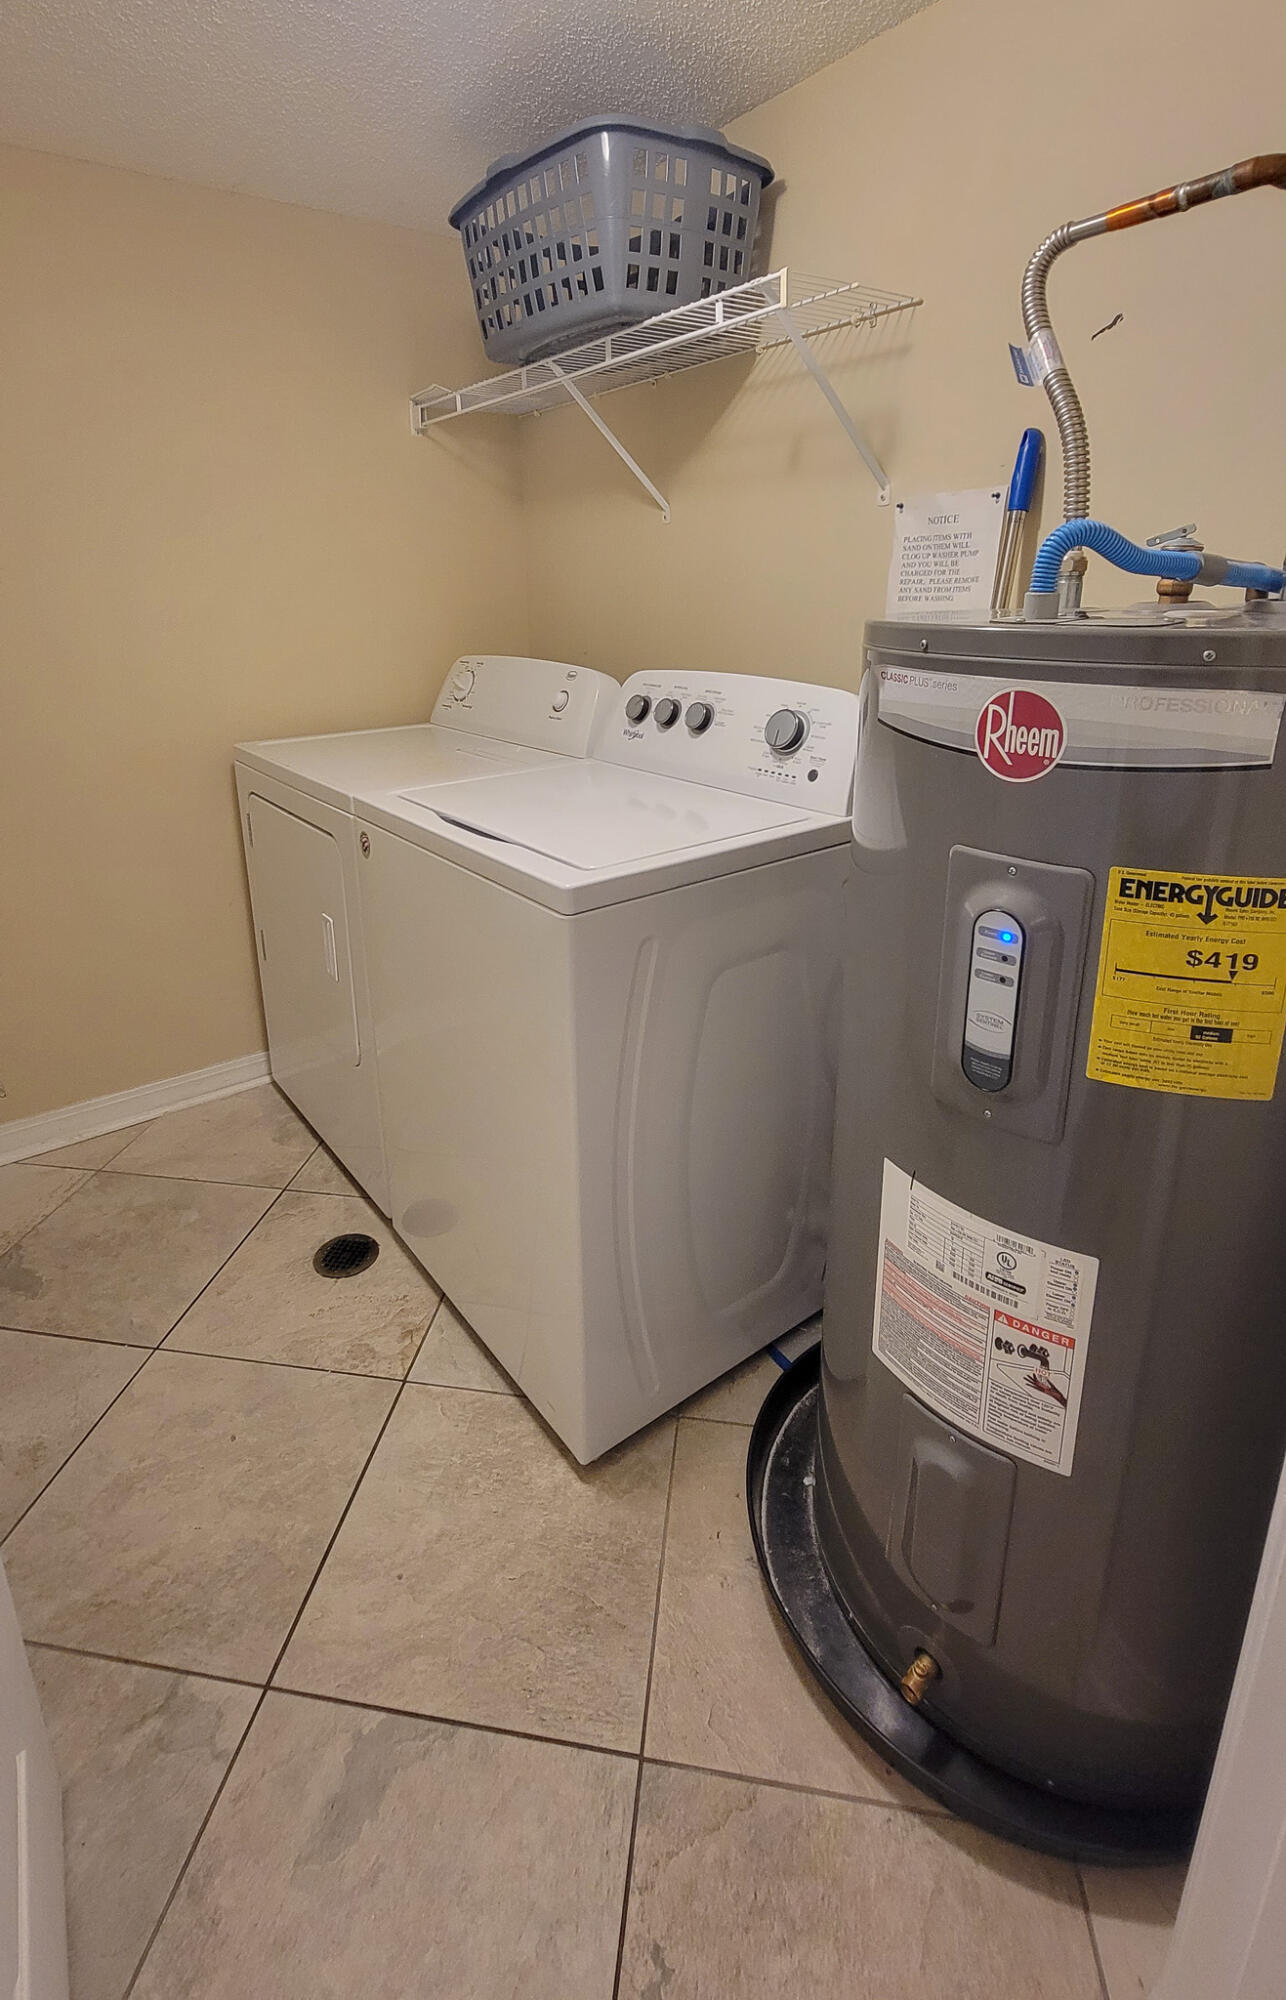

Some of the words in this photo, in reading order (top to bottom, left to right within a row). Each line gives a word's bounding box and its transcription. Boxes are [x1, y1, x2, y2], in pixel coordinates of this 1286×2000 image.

[928, 514, 959, 525] NOTICE
[881, 671, 908, 684] CLASSIC
[932, 680, 958, 691] series
[1121, 696, 1272, 714] PROFESSIONA
[984, 691, 1060, 766] Rheem
[1146, 930, 1179, 939] Estimated
[1205, 936, 1228, 944] Energy
[1186, 950, 1259, 970] $419
[1199, 1011, 1220, 1019] Rating
[1013, 1320, 1069, 1346] DANGER
